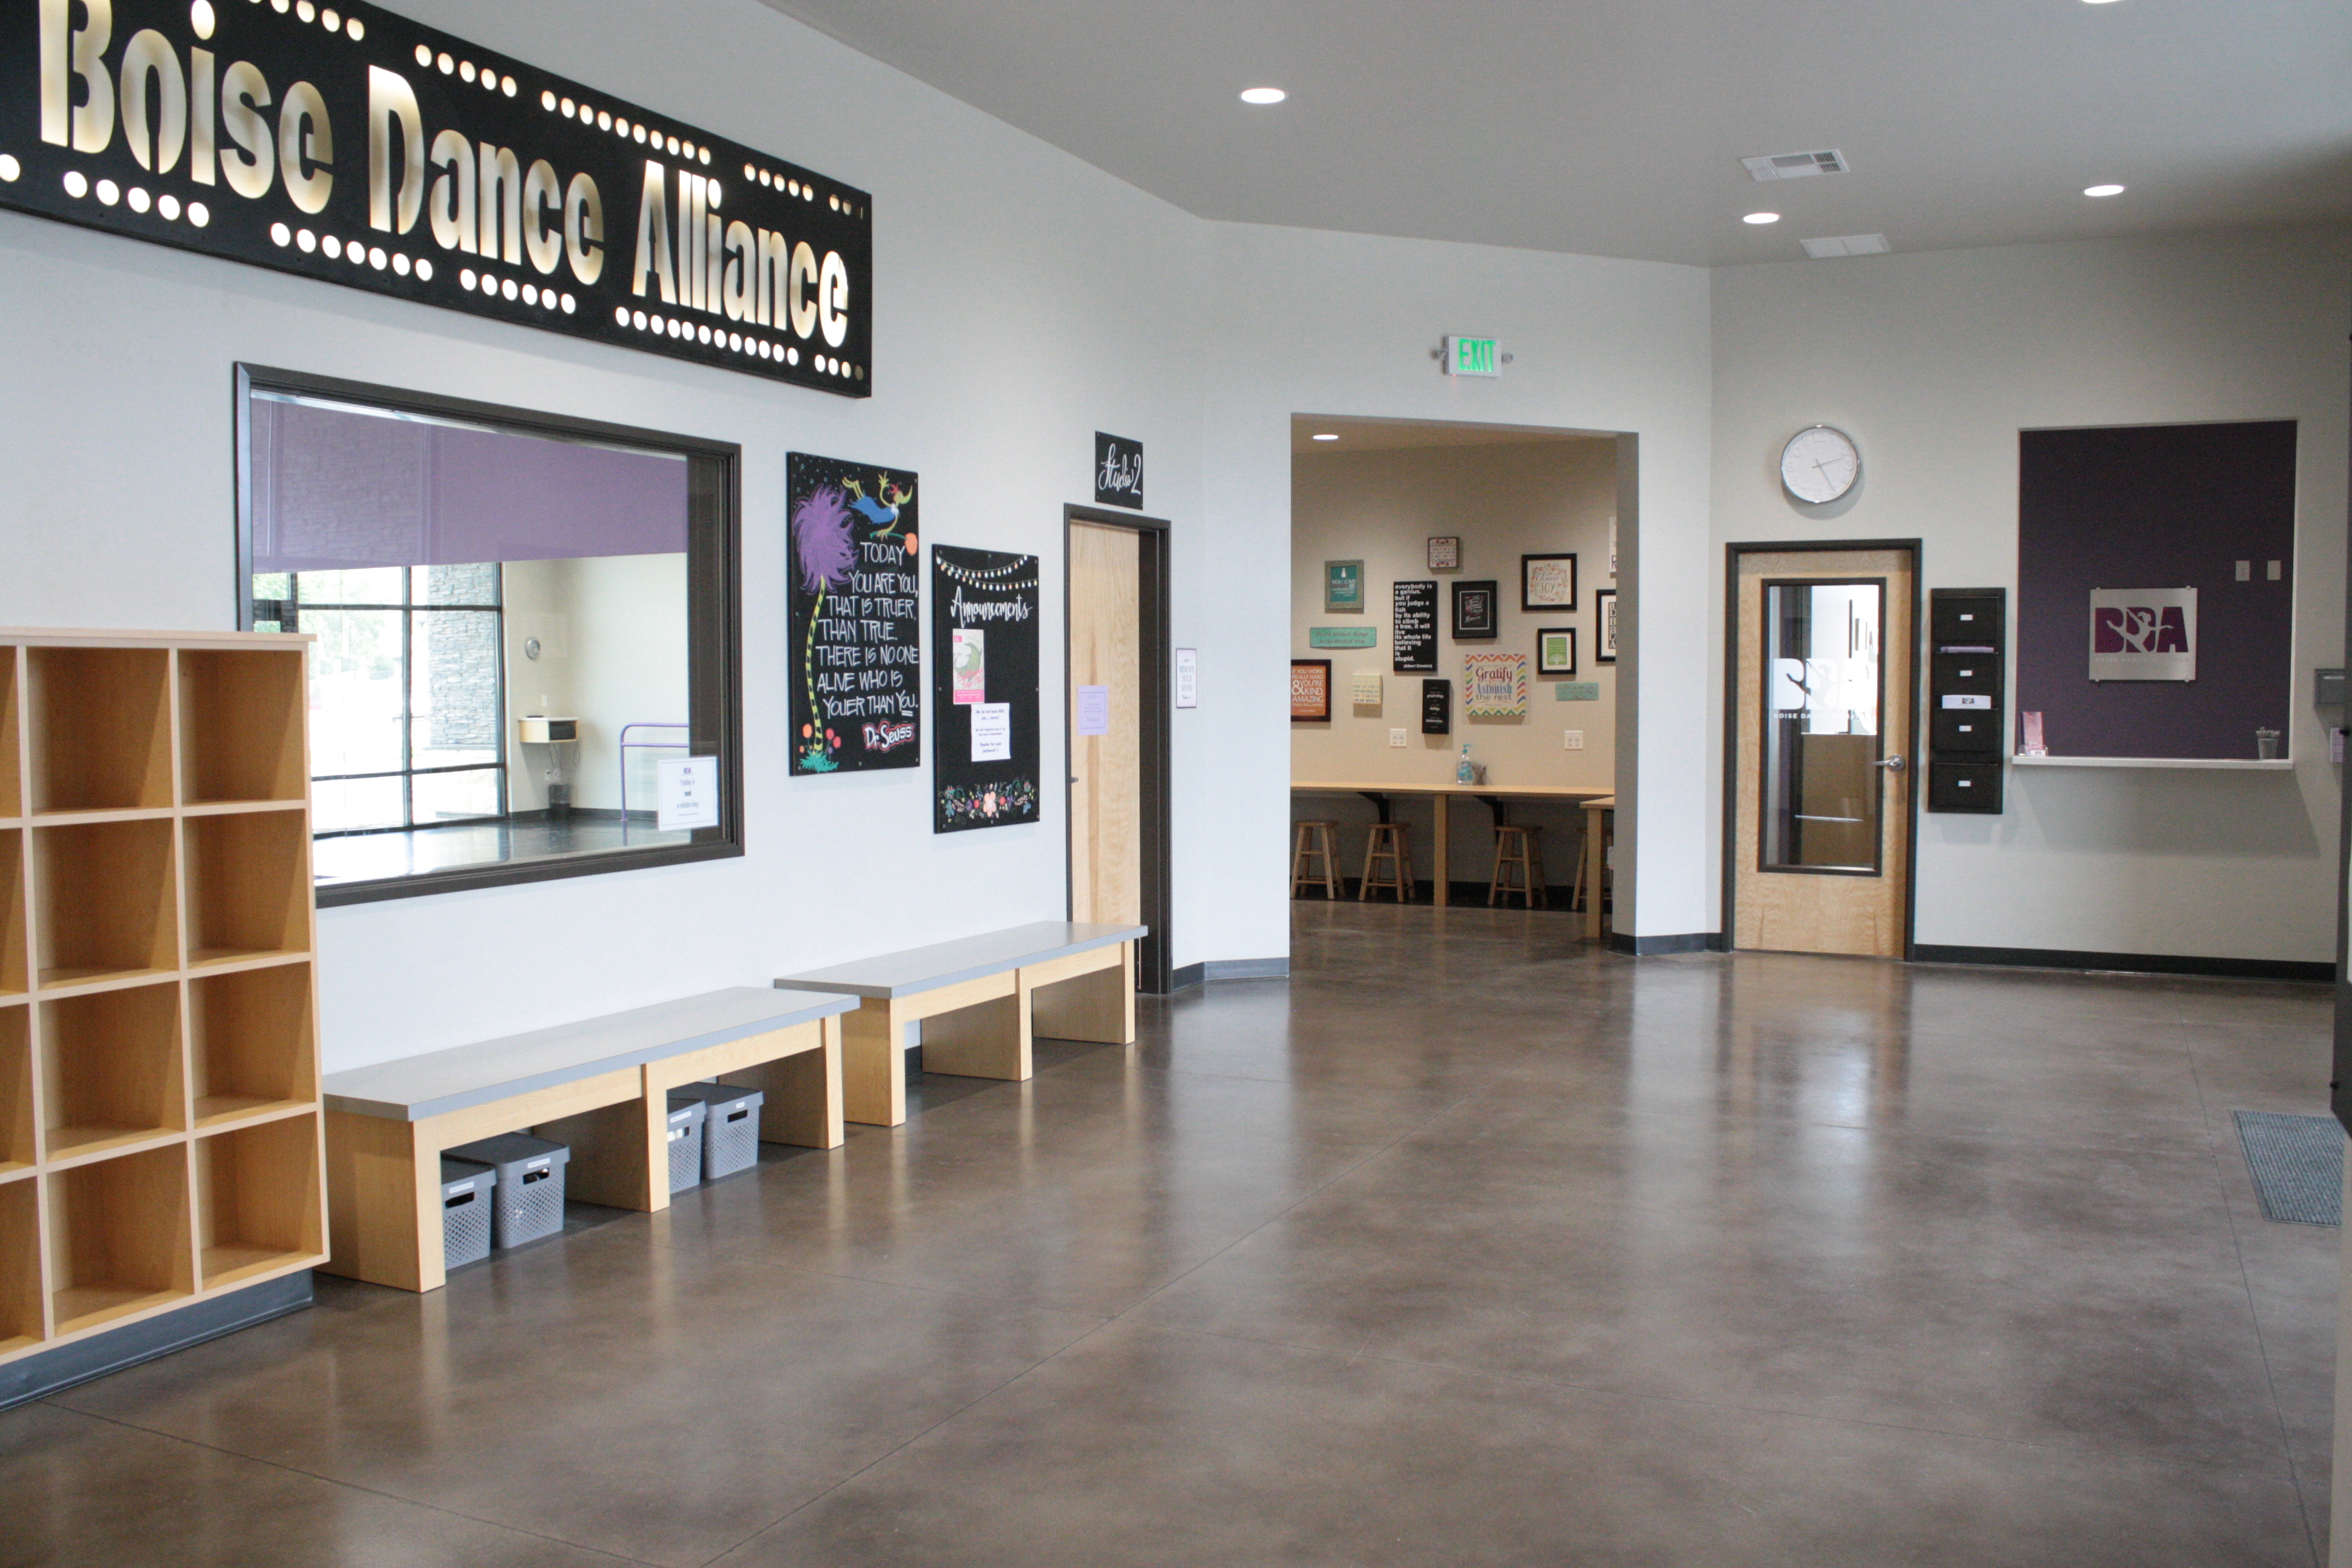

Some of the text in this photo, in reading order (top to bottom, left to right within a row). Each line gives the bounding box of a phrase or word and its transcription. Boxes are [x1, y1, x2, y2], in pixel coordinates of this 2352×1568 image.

[39, 0, 849, 348] Boise Dance Alliance
[1458, 338, 1496, 373] EXIT
[1099, 443, 1142, 495] Studio 2
[860, 541, 905, 566] TODAY
[849, 570, 918, 598] YOU ARE YOU,
[1538, 582, 1556, 594] JOY
[826, 595, 859, 616] THAT
[861, 598, 873, 616] IS
[950, 585, 1033, 629] Announcements
[817, 618, 898, 644] THAN TRUE.
[2094, 607, 2189, 653] BDA
[815, 644, 919, 667] THERE IS NO ONE
[817, 669, 903, 694] ALIVE WHO IS
[1292, 679, 1305, 695] &
[1475, 667, 1512, 682] Gratify
[1477, 682, 1512, 694] Astonish
[823, 690, 918, 719] YOUER THAN YOU.
[864, 724, 913, 748] Dr Seuss
